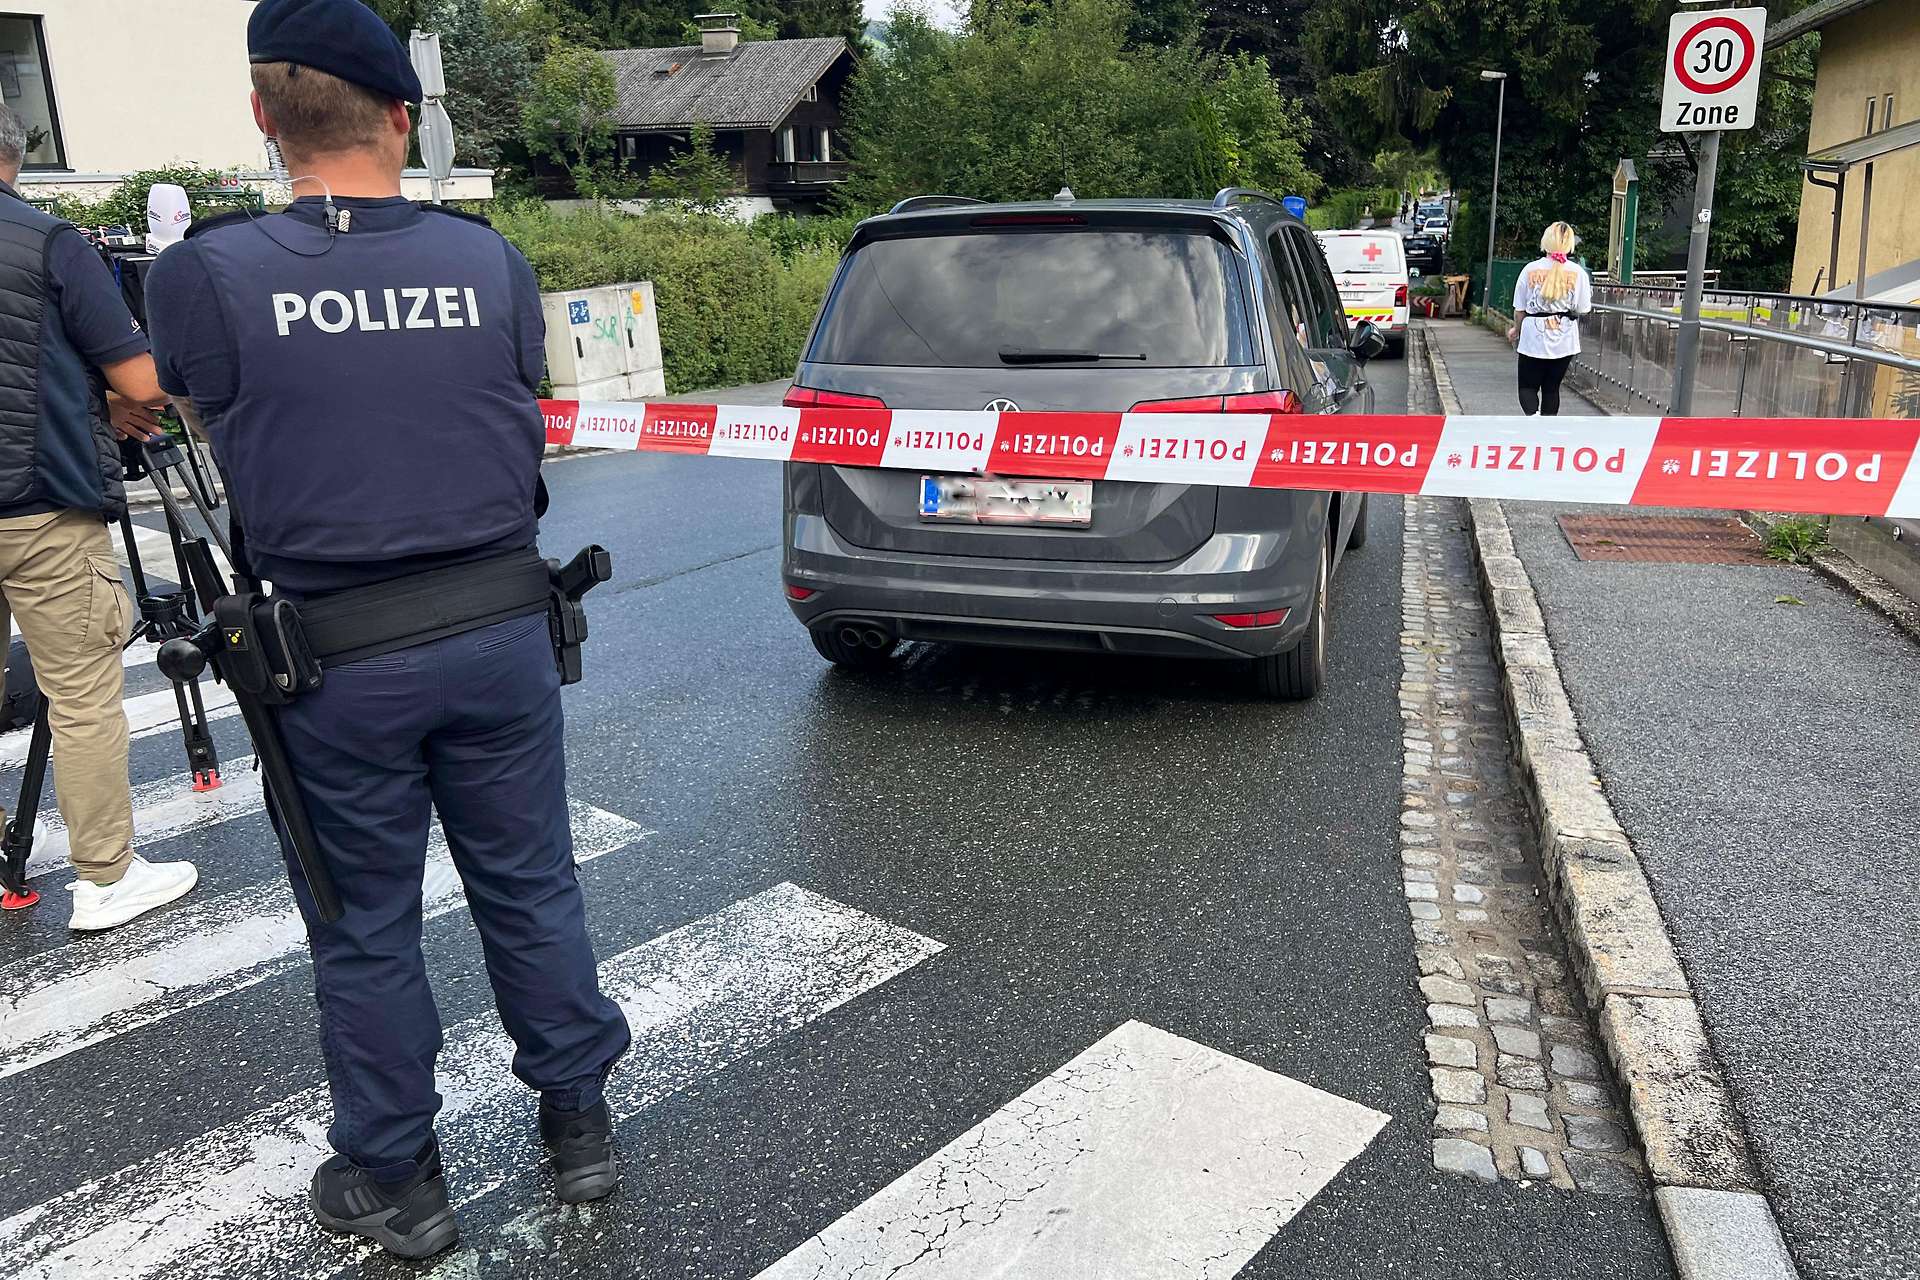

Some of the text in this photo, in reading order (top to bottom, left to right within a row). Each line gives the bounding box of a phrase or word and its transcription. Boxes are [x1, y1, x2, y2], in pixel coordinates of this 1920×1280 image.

[1693, 39, 1733, 73] 30
[1676, 102, 1738, 125] Zone
[272, 287, 480, 336] POLIZEI
[542, 415, 571, 429] POLI
[587, 417, 636, 433] POLIZEI
[654, 420, 708, 438] POLIZEI
[729, 423, 789, 442] POLIZEI
[811, 426, 880, 447] POLIZEI
[905, 430, 984, 452] POLIZEI
[1014, 434, 1103, 457] POLIZEI
[1139, 438, 1246, 461] POLIZEI
[1290, 442, 1417, 467] POLIZEI
[1471, 445, 1626, 473] POLIZEI
[1690, 449, 1882, 483] POLIZEI
